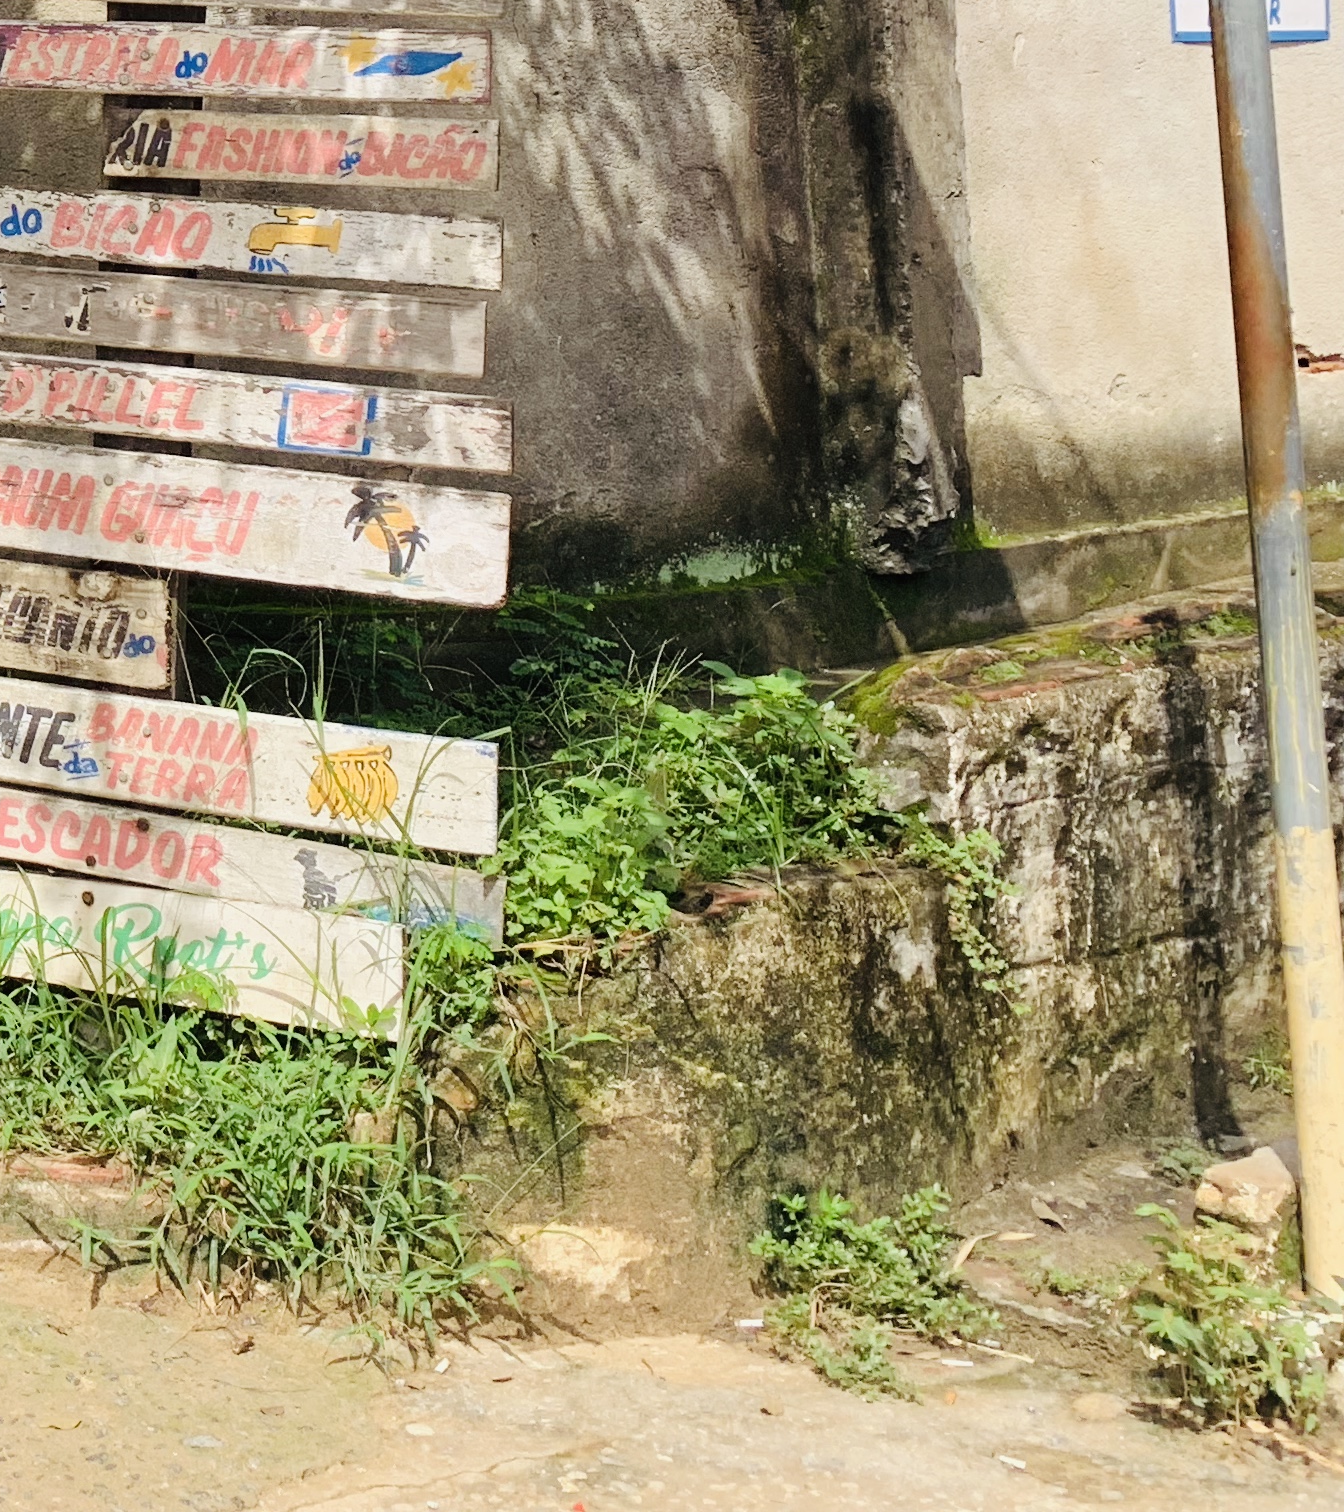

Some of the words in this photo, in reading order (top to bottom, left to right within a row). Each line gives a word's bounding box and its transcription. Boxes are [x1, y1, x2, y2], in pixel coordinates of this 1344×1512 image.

[7, 32, 180, 83] ESTRELA
[175, 50, 208, 79] do
[205, 37, 316, 88] MAR
[173, 122, 348, 173] FASHION
[0, 204, 42, 238] do
[87, 702, 260, 766] BANANA
[106, 751, 250, 812] TERRA
